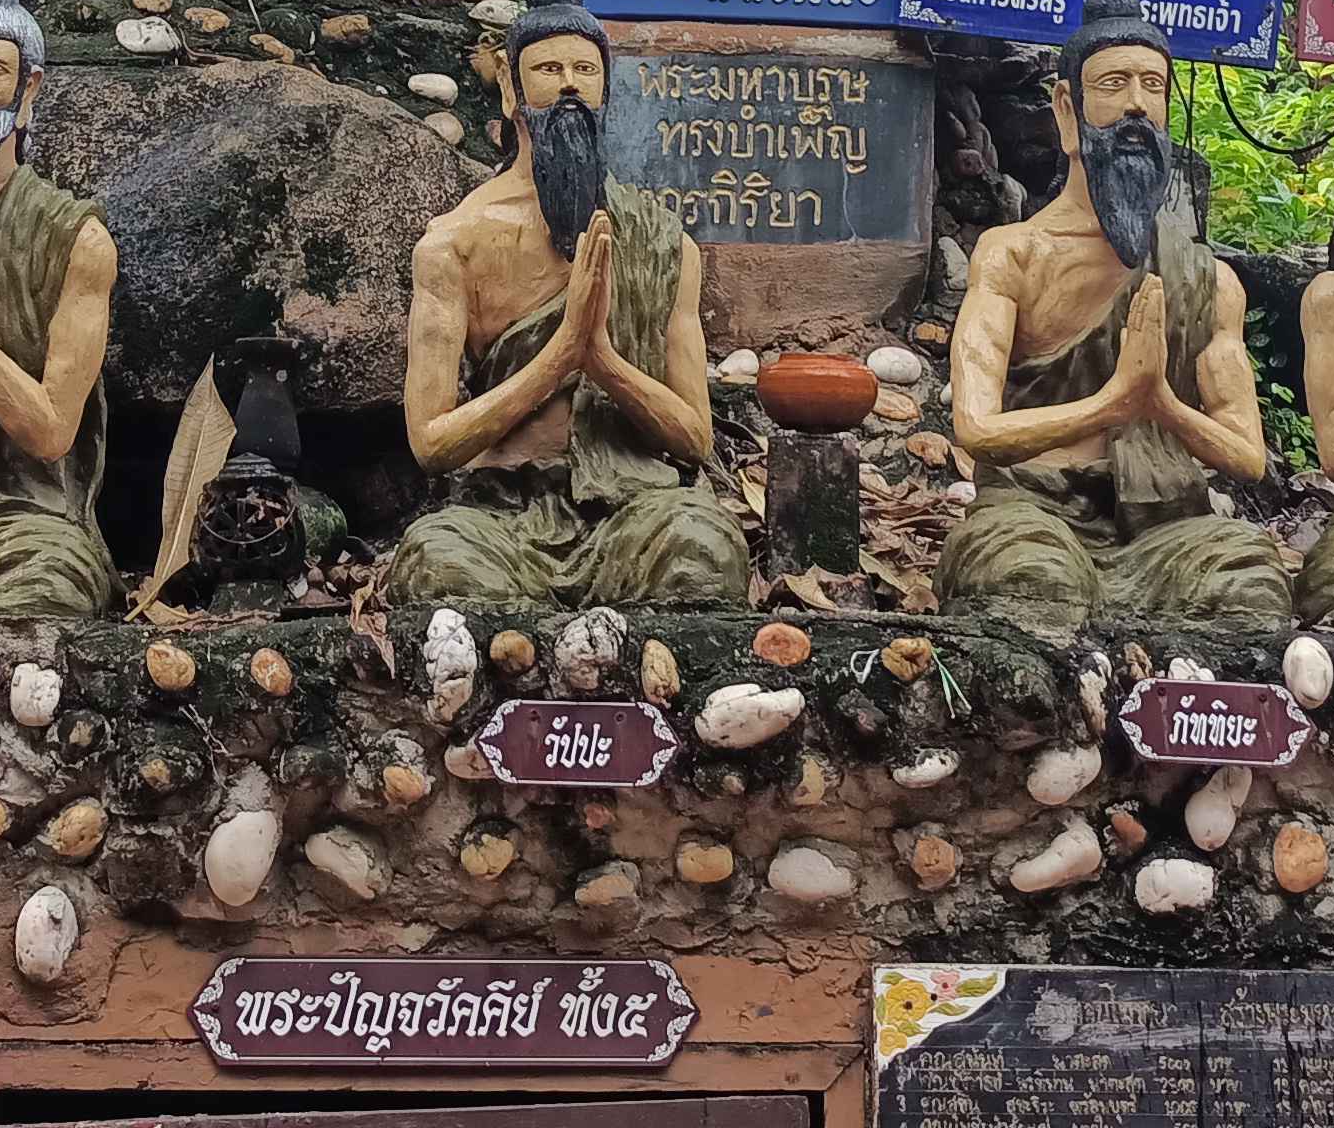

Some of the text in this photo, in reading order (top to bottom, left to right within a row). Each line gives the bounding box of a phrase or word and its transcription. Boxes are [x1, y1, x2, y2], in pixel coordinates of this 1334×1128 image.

[542, 721, 613, 771] วัปปะ
[1169, 693, 1257, 749] ภัททิยะ
[234, 966, 658, 1054] พระปัญจวัคคีย์ ทั้ง๕
